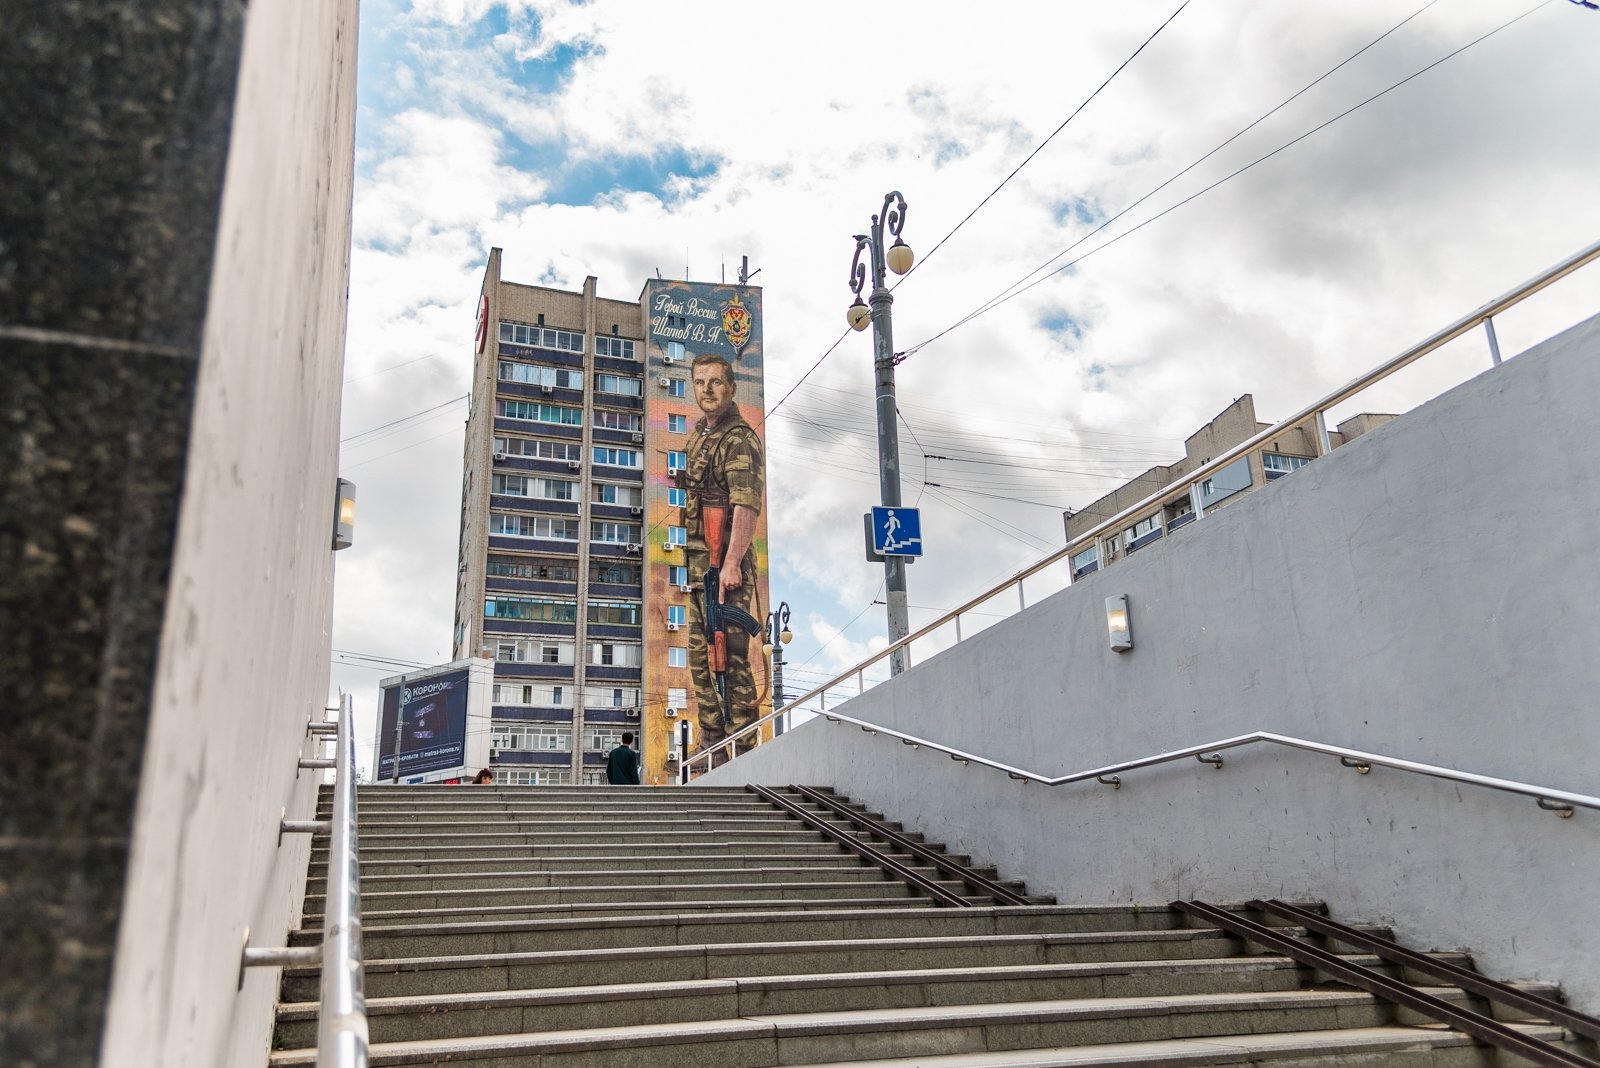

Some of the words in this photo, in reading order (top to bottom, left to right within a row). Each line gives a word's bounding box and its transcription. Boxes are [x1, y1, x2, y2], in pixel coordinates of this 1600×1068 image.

[654, 294, 684, 317] Герой
[685, 297, 718, 320] России
[652, 315, 693, 340] Шатов
